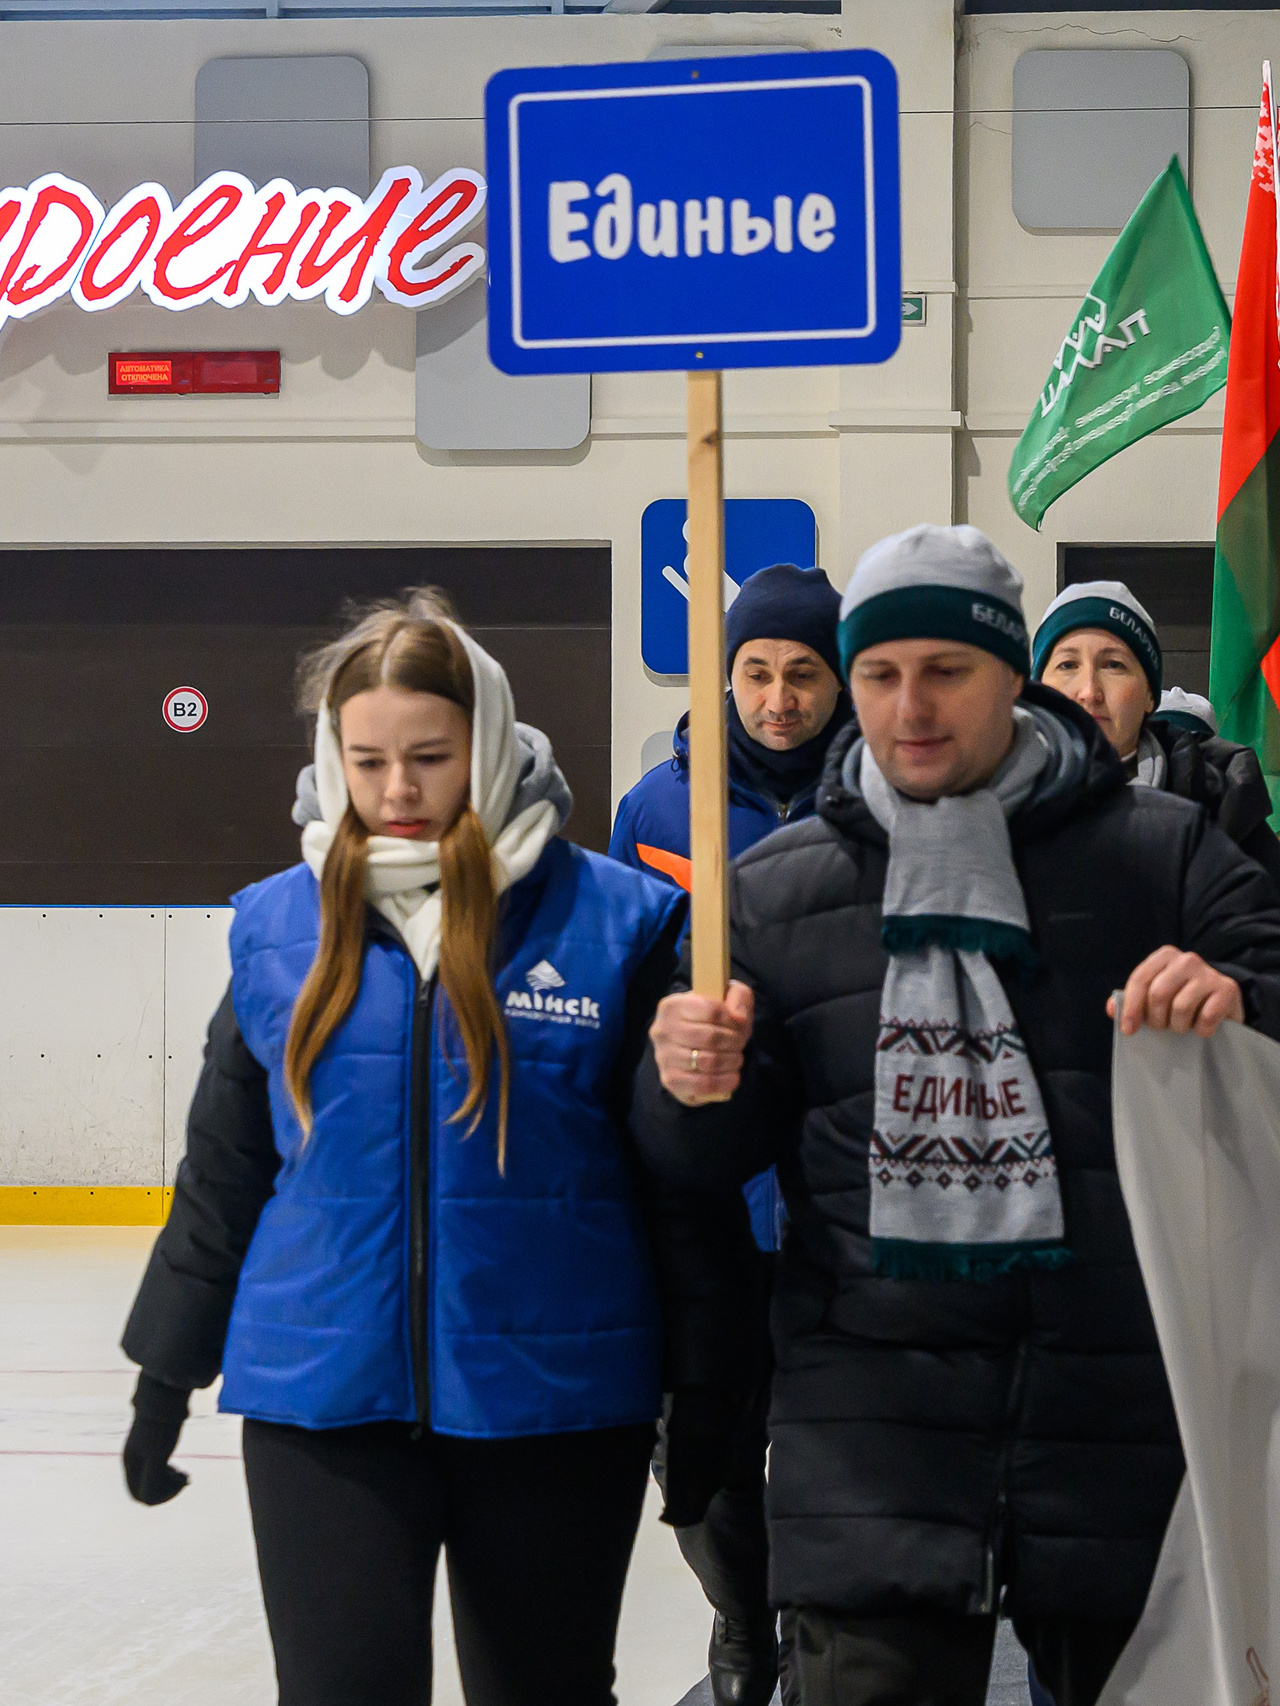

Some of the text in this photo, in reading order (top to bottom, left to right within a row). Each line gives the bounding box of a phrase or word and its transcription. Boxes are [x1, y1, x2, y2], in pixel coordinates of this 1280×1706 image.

[549, 173, 836, 264] Единые
[120, 365, 169, 373] АВТОМАТИКА
[121, 373, 168, 381] ОТКЛЮЧЕНА
[173, 702, 197, 717] B2
[893, 1073, 1026, 1123] ЕДИНЫЕ
